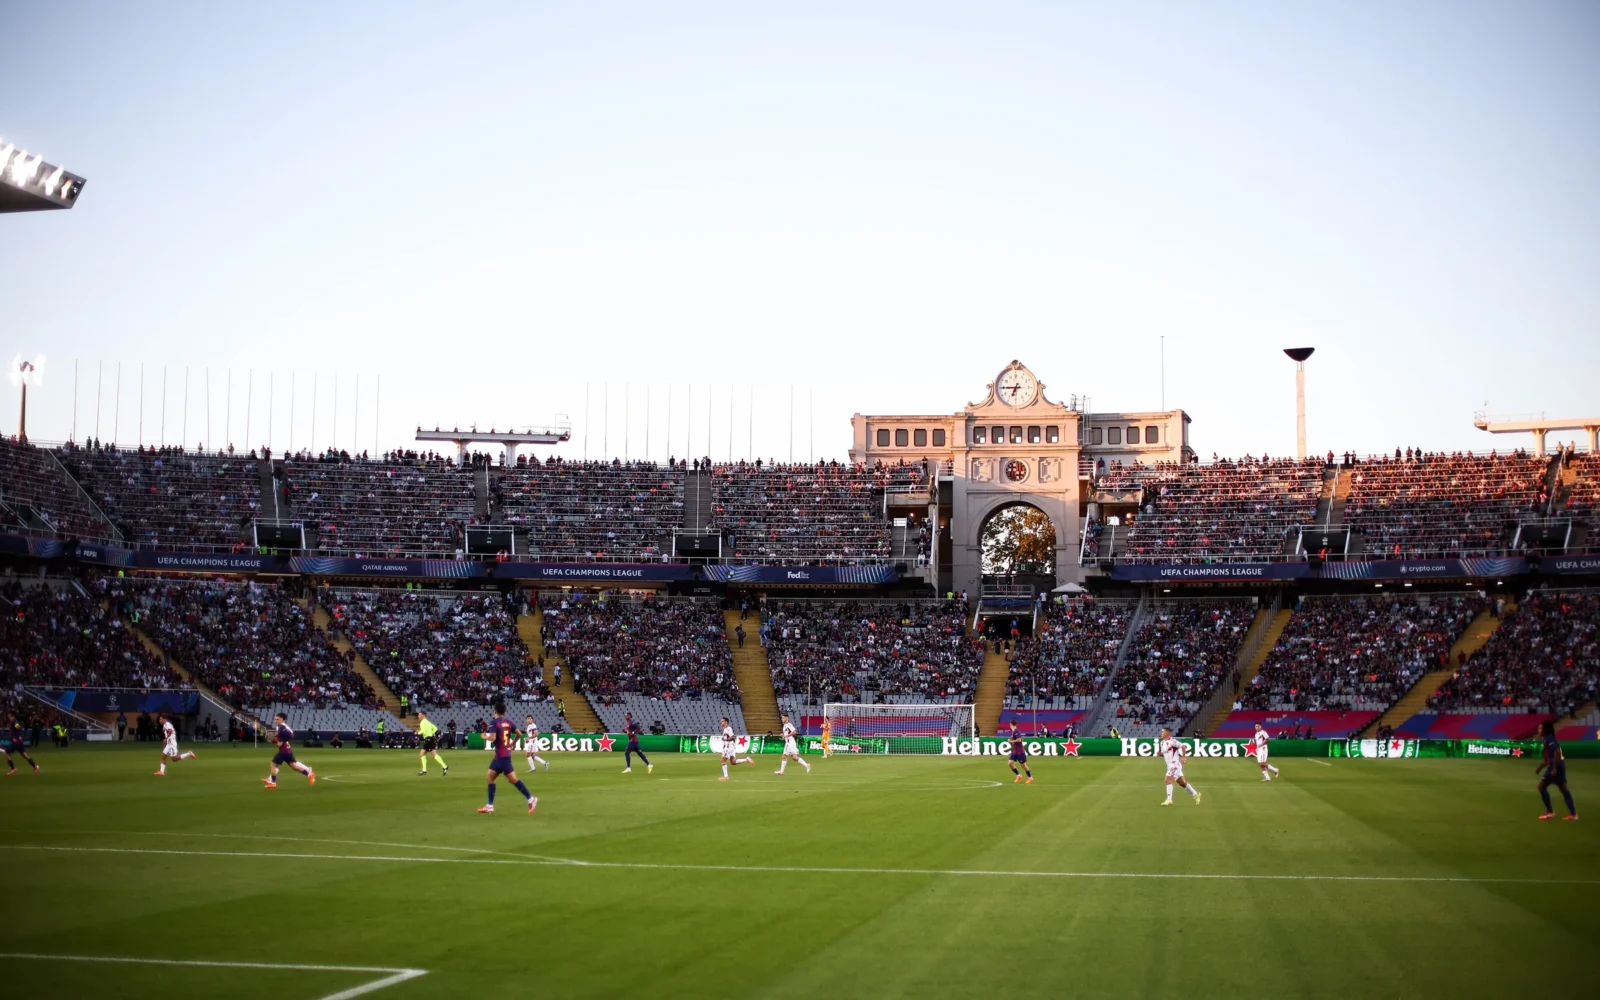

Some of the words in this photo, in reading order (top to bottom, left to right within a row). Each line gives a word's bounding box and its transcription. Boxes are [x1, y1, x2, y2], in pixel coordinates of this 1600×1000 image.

[84, 550, 98, 558] PEPSI
[157, 557, 179, 565] UEFA
[180, 558, 228, 566] CHAMPIONS
[230, 559, 261, 568] LEAGUE
[1556, 561, 1578, 569] UEFA
[504, 730, 509, 746] 5
[941, 737, 1058, 756] Heineen
[1120, 738, 1240, 758] Heieken
[1468, 744, 1510, 756] Heineken
